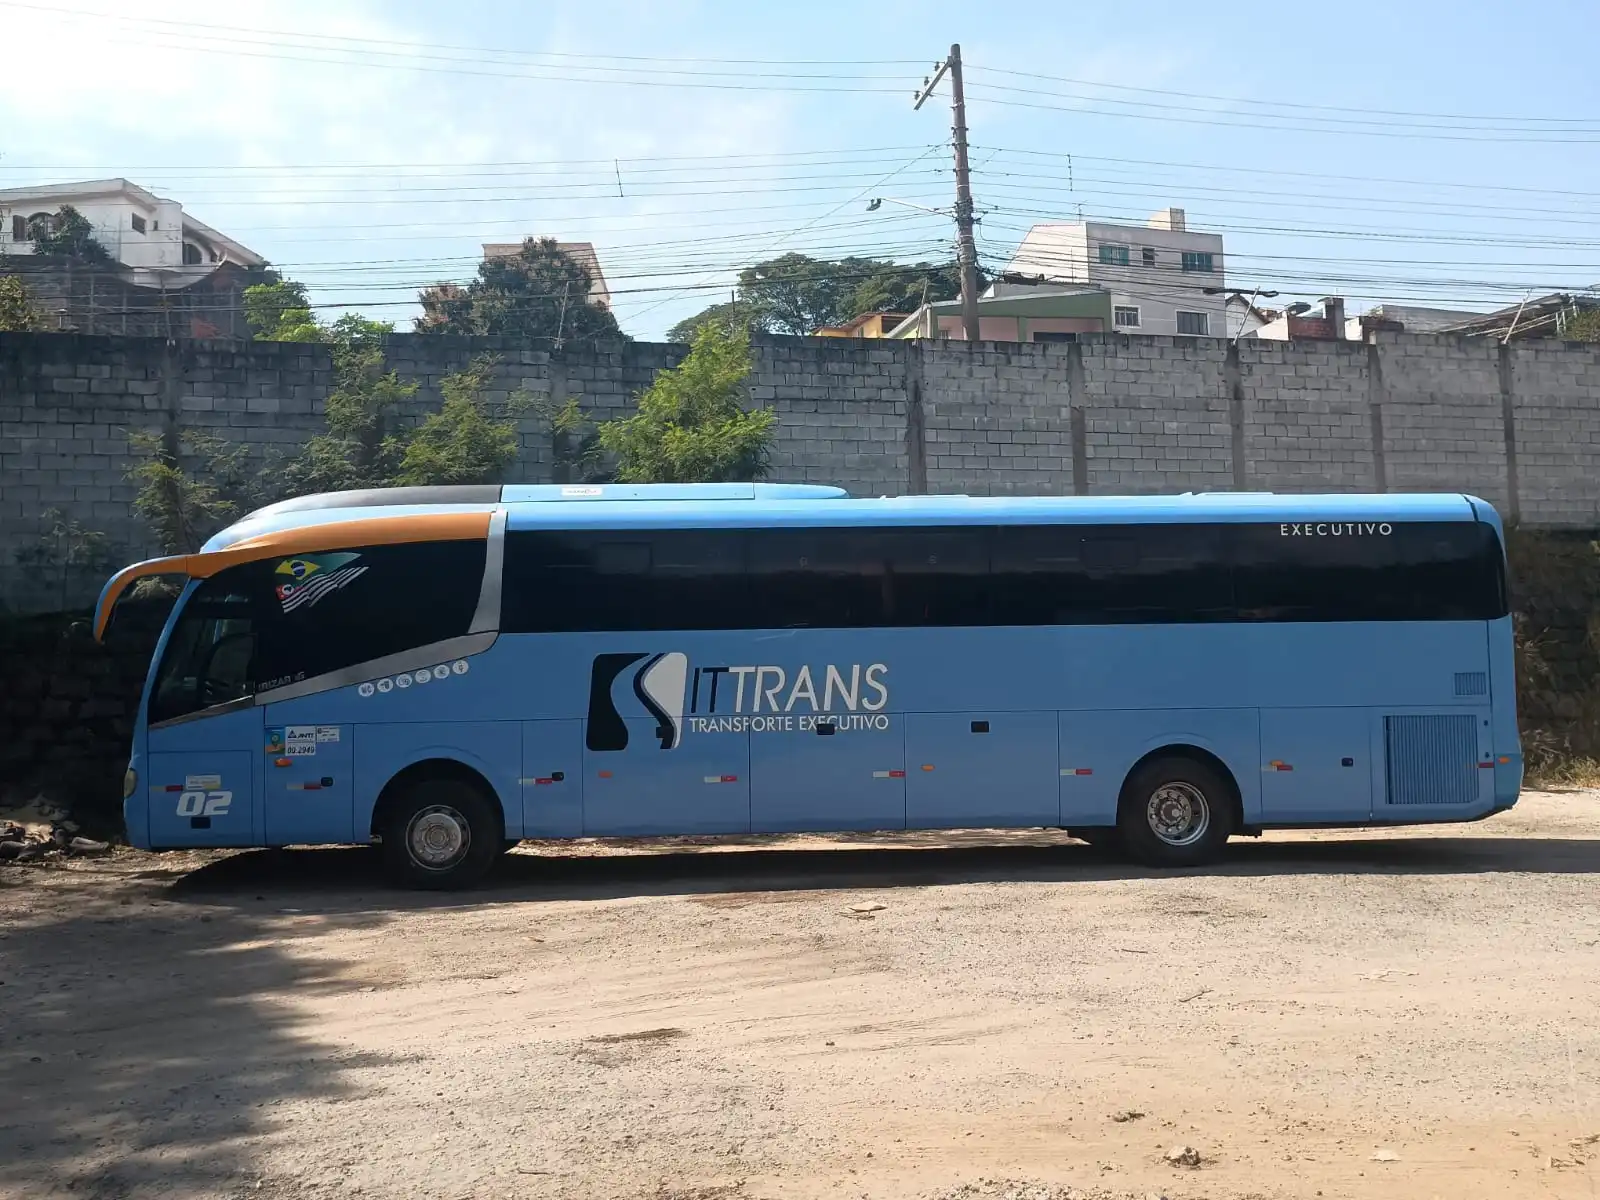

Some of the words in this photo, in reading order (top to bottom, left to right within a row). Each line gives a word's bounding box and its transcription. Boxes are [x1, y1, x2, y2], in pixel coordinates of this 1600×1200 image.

[1280, 523, 1393, 536] EXECUTIVO
[689, 716, 793, 733] TRANSPORTE
[176, 791, 232, 816] 02
